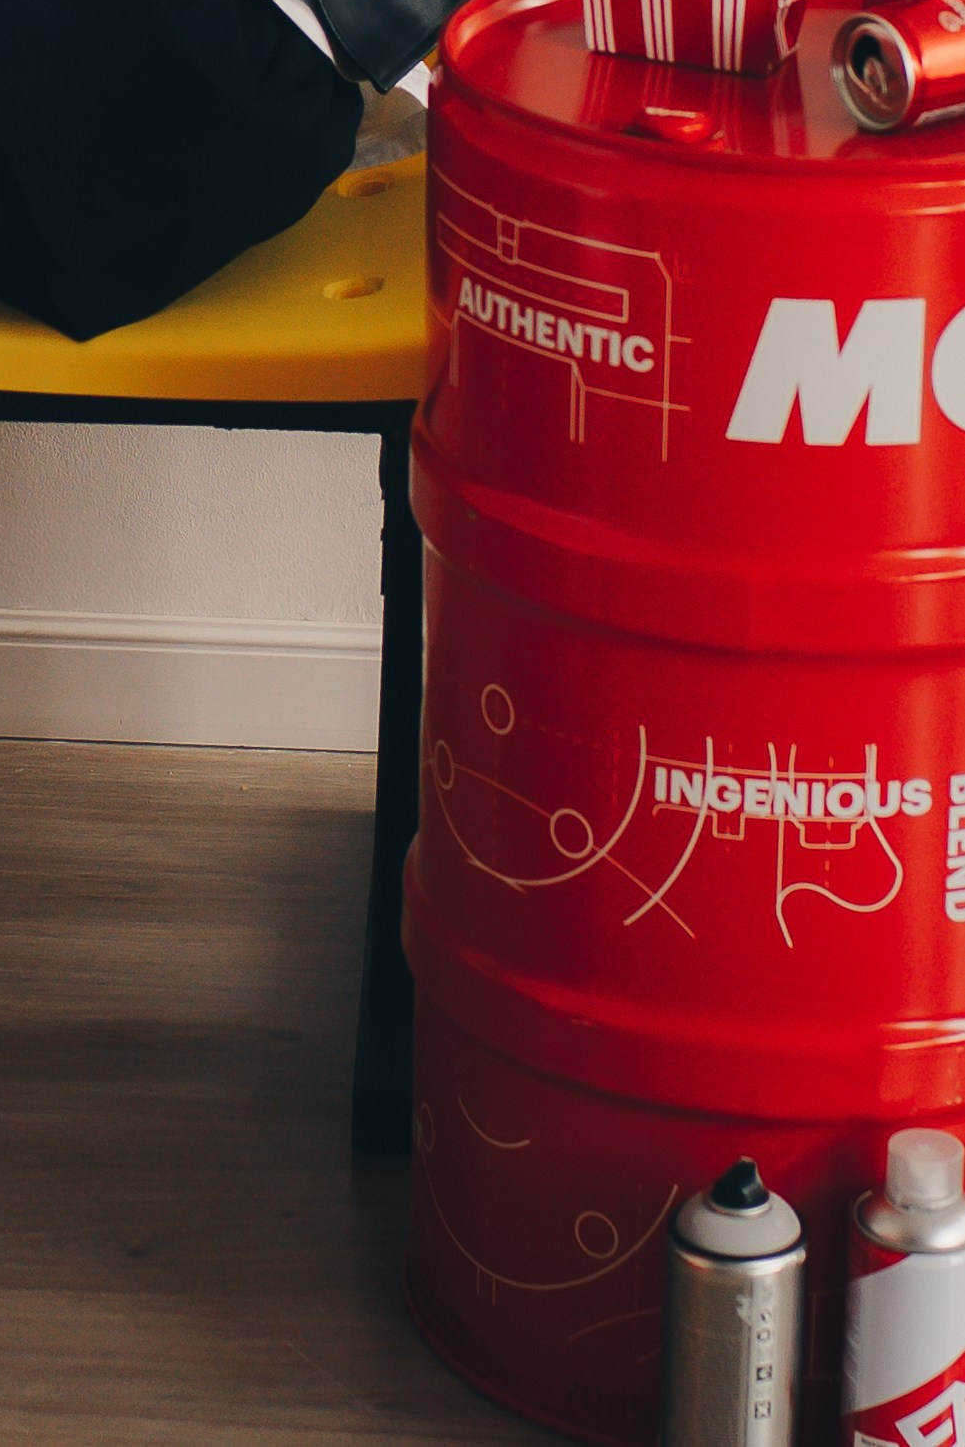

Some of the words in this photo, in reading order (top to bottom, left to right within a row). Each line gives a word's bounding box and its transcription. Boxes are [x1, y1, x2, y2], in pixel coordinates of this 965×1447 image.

[458, 276, 655, 374] AUTHENTIC
[725, 297, 965, 446] M
[654, 765, 934, 819] INGENIOUS
